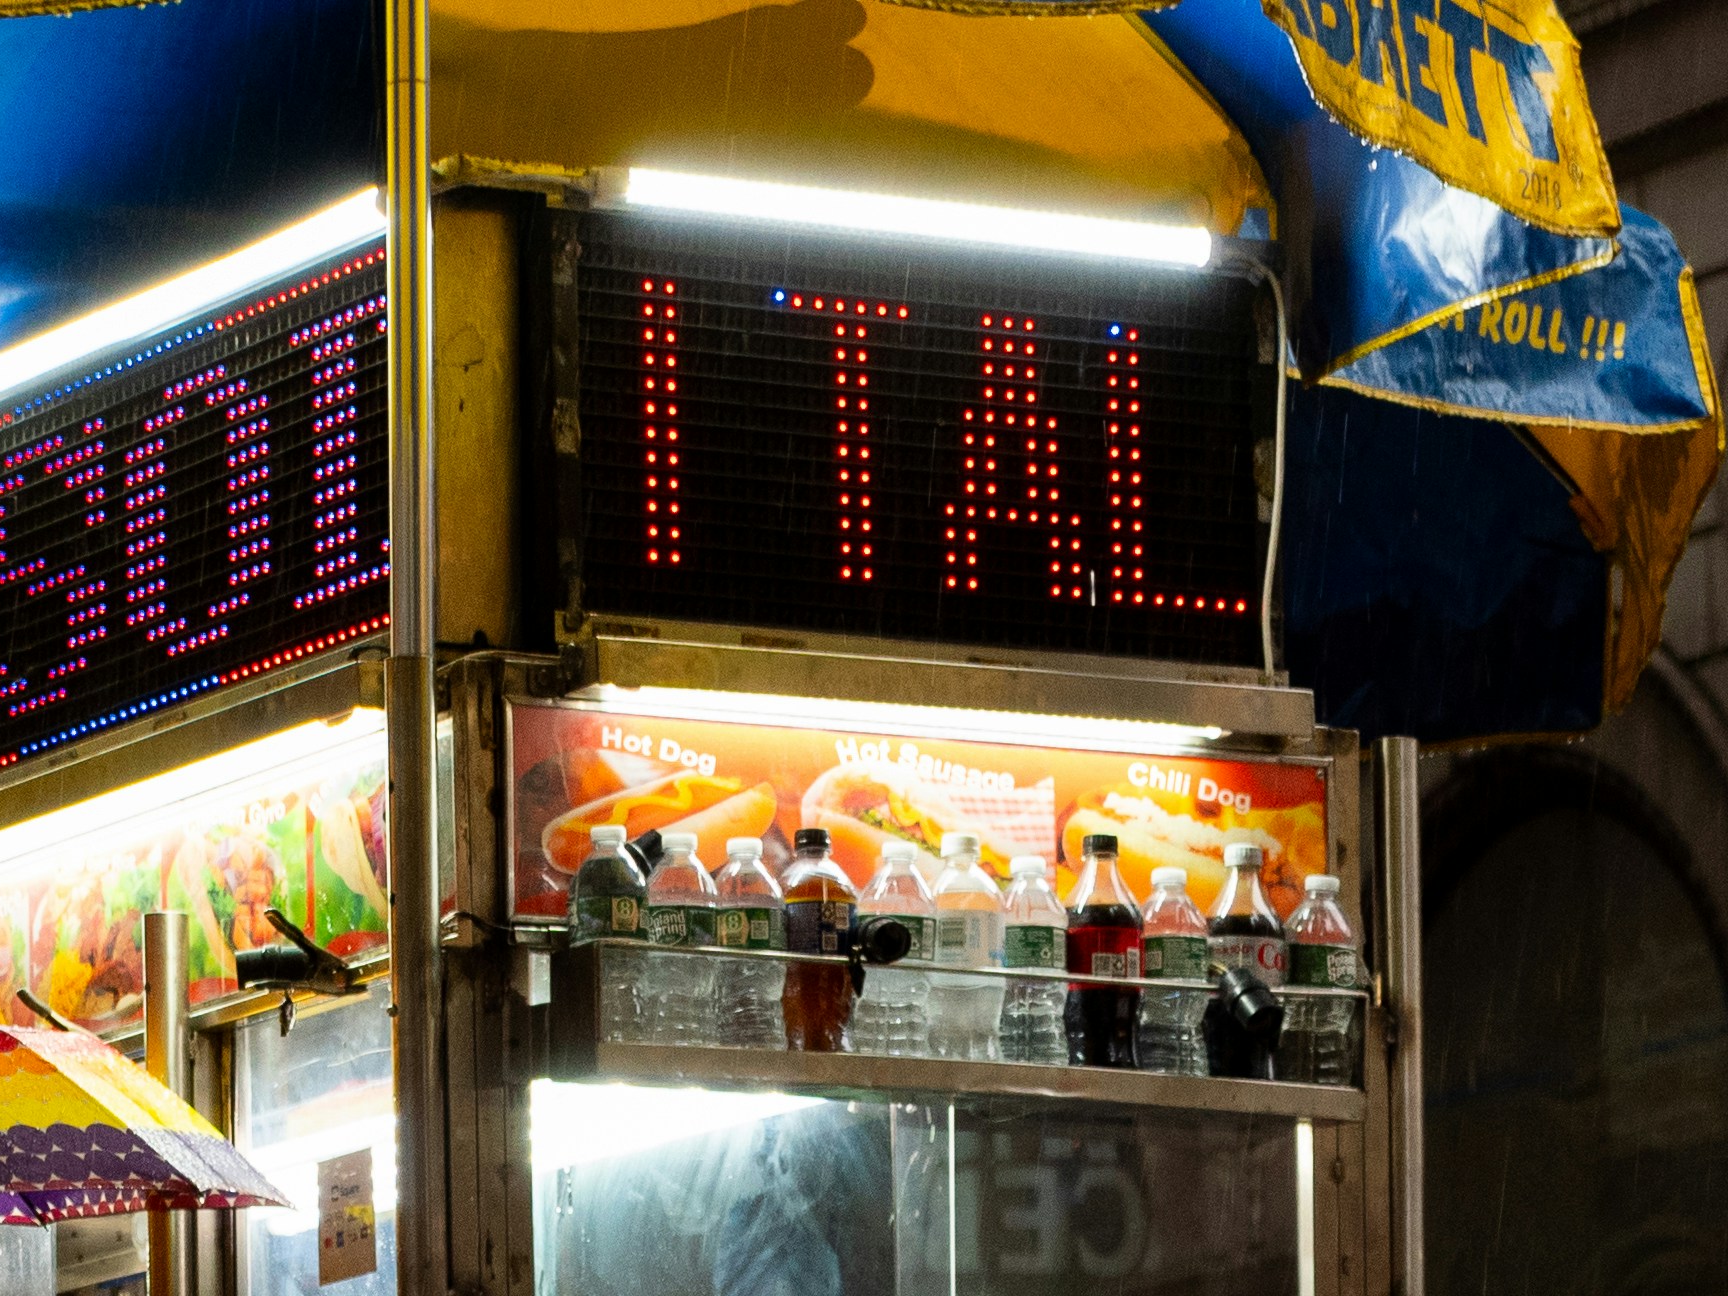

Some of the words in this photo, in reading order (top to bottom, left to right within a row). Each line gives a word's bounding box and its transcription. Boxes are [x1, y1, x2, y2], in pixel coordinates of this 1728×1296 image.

[1518, 167, 1563, 211] 2018
[1479, 300, 1567, 355] ROLL
[601, 726, 653, 753] Hot
[659, 737, 717, 777] Dog
[834, 737, 892, 767] Hot
[897, 741, 1016, 795] Sausage
[1127, 761, 1191, 797] Chili
[1197, 777, 1253, 816] Dog
